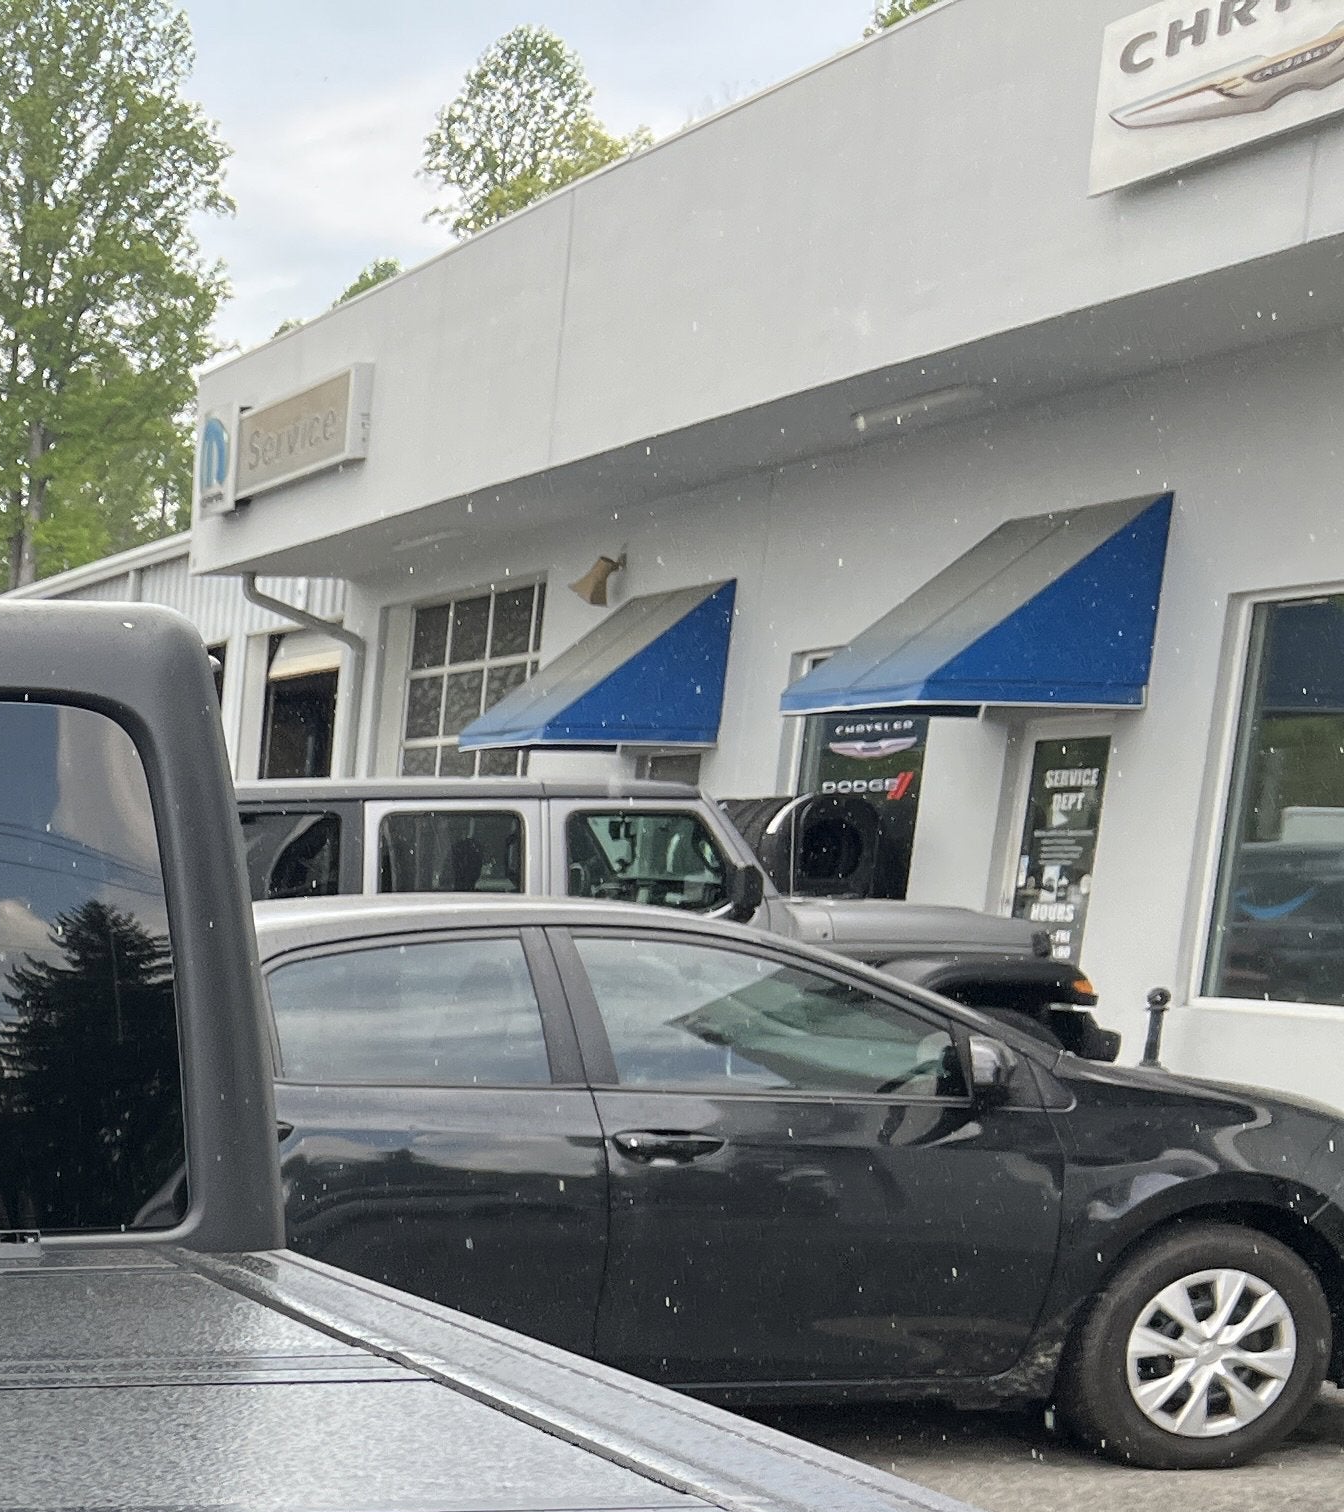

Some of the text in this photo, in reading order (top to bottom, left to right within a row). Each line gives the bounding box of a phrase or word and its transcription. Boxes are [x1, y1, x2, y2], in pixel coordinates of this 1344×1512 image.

[248, 409, 338, 471] Service
[822, 778, 899, 794] DODGE
[1045, 768, 1100, 789] SERVICE
[1052, 792, 1086, 811] DEPT
[1030, 902, 1075, 922] HOURS
